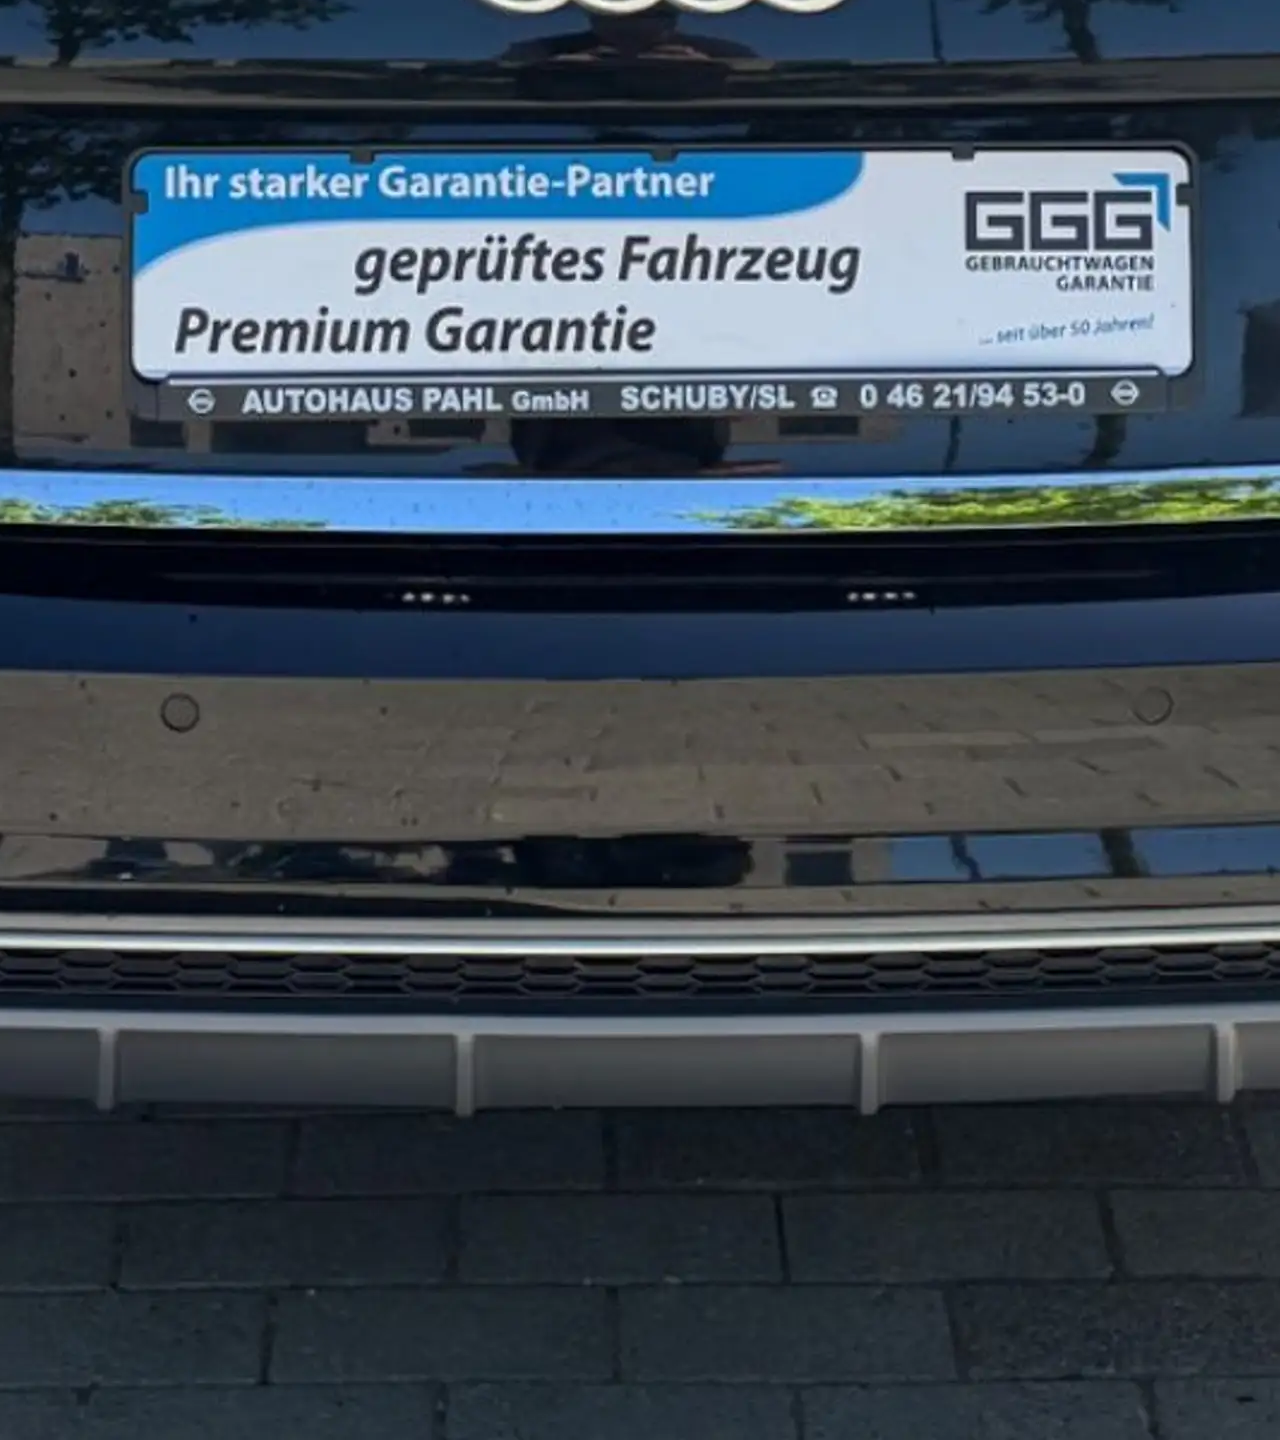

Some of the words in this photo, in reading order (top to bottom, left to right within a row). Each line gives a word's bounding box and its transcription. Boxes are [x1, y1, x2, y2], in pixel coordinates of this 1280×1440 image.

[165, 164, 222, 199] Ihr
[228, 164, 371, 200] starker
[378, 164, 715, 199] Garantie-Partner
[965, 191, 1153, 251] GGG
[354, 233, 605, 295] geprüftes
[618, 233, 861, 295] Fahrzeug
[965, 256, 1155, 272] GEBRAUCHTWAGEN
[1056, 275, 1155, 292] GARANTIE
[174, 306, 411, 355] Premium
[424, 305, 656, 353] Garantie
[996, 327, 1024, 344] seit
[1028, 323, 1066, 341] über
[1070, 319, 1090, 336] 50
[242, 387, 413, 414] AUTOHAUS
[422, 387, 503, 413] PAHL
[511, 389, 589, 412] GmbH
[620, 383, 795, 411] SCHUBY/SL
[860, 383, 878, 408] 0
[886, 382, 924, 408] 46
[932, 381, 1014, 408] 21/94
[1023, 381, 1086, 407] 53-0
